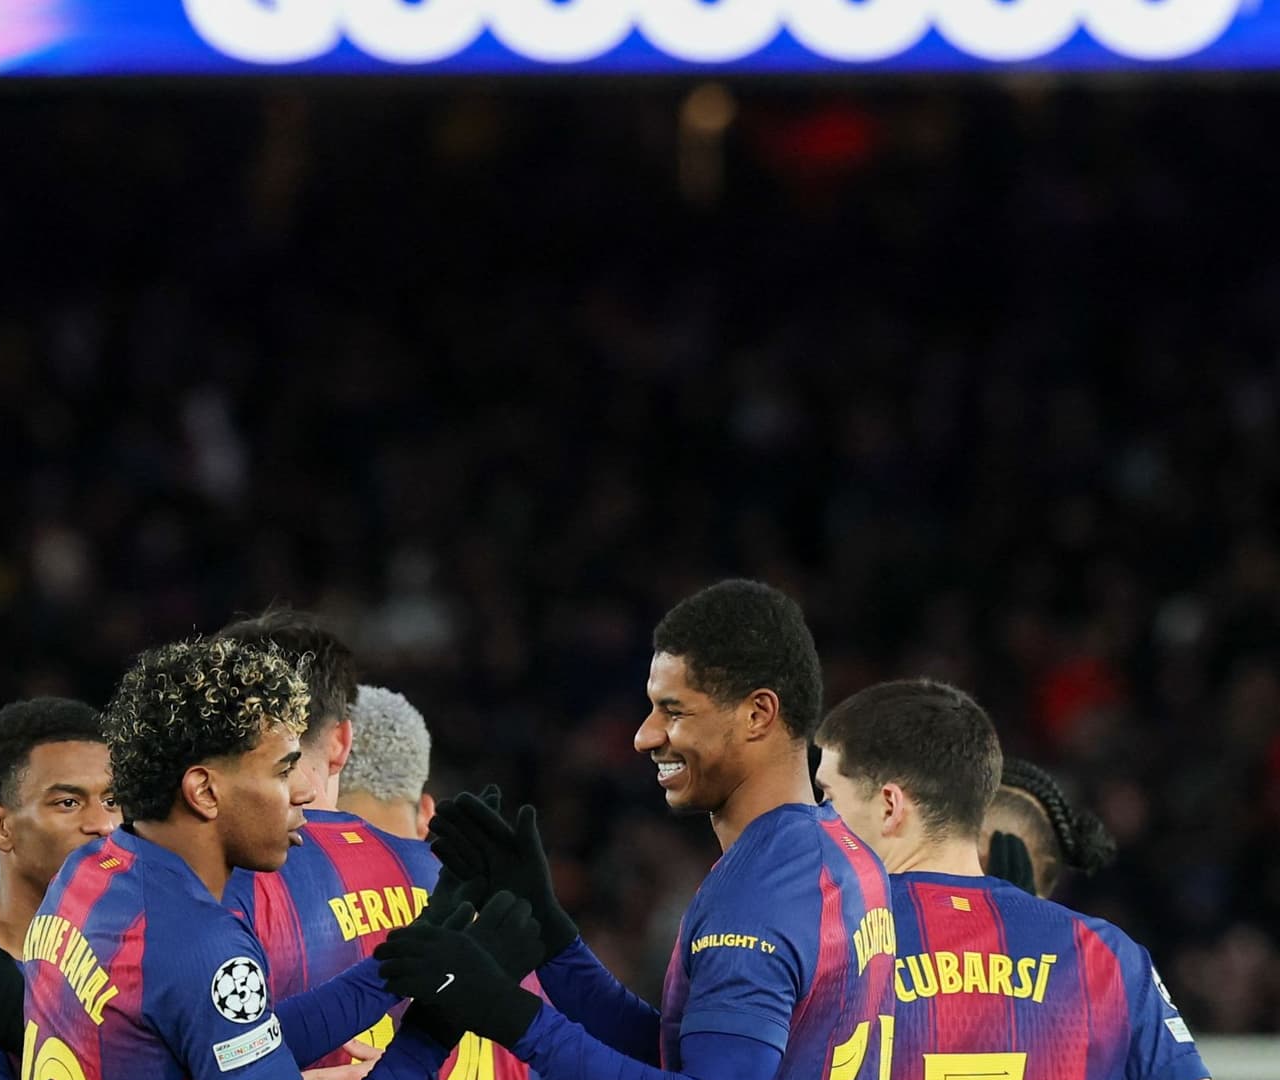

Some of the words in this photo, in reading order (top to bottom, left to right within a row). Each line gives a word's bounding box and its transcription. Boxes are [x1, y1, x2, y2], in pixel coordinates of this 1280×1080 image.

[328, 886, 430, 941] BERNA
[761, 940, 776, 954] tv
[59, 926, 119, 1026] YAMAL
[894, 951, 1058, 1004] CUBARSÍ
